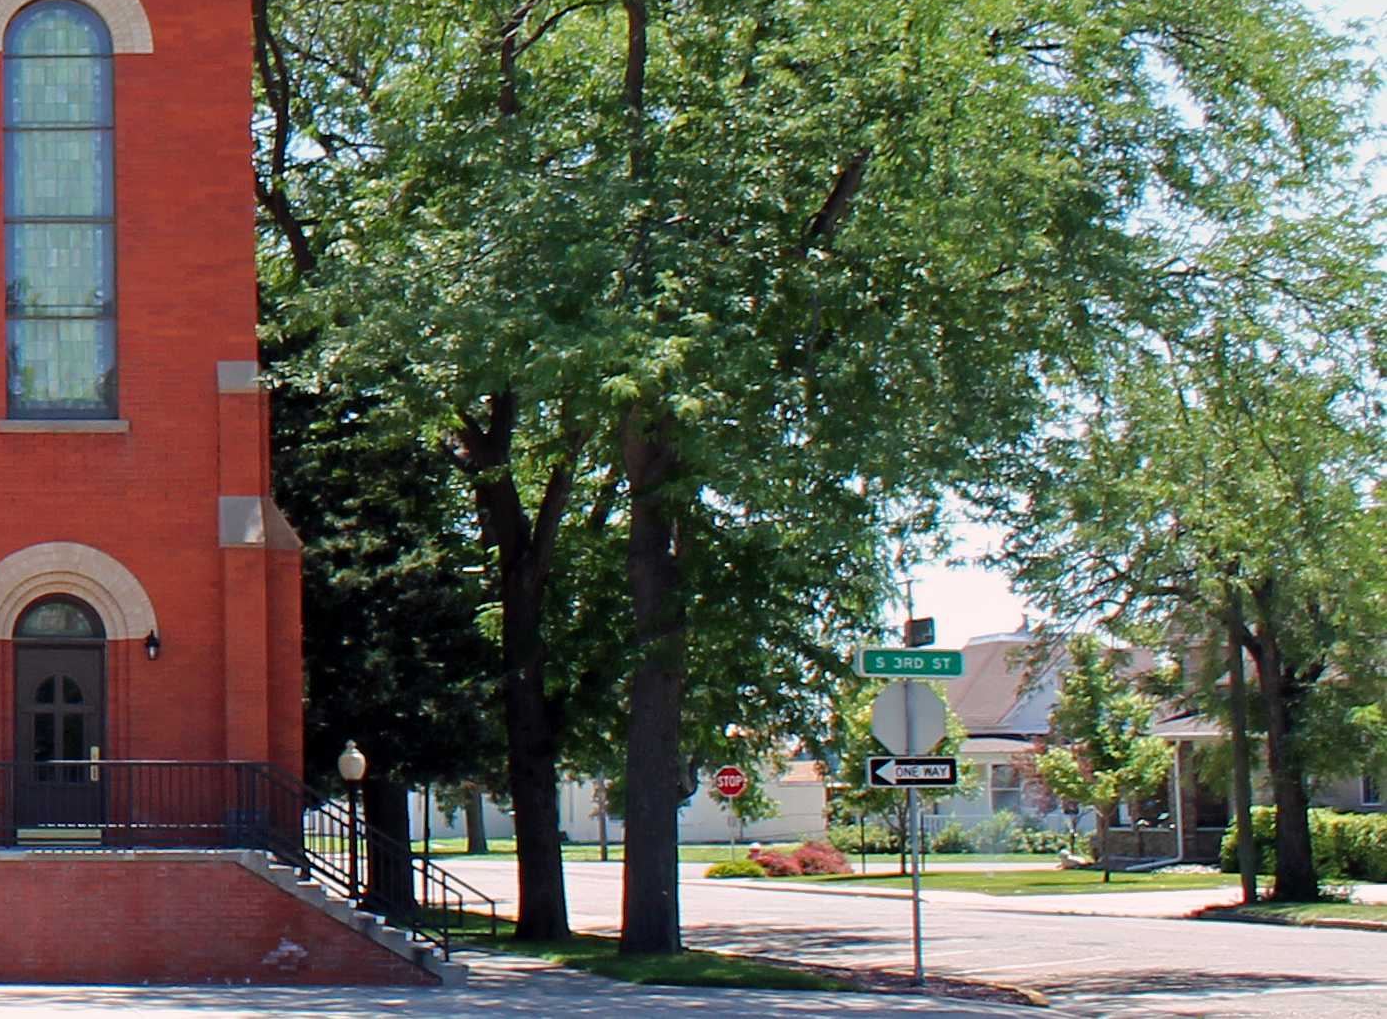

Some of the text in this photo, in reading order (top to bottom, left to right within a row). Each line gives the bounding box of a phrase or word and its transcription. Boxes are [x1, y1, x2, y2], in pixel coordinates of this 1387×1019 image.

[875, 656, 952, 670] S 3RD ST
[895, 766, 948, 777] ONE WAY
[717, 775, 743, 787] STOP
